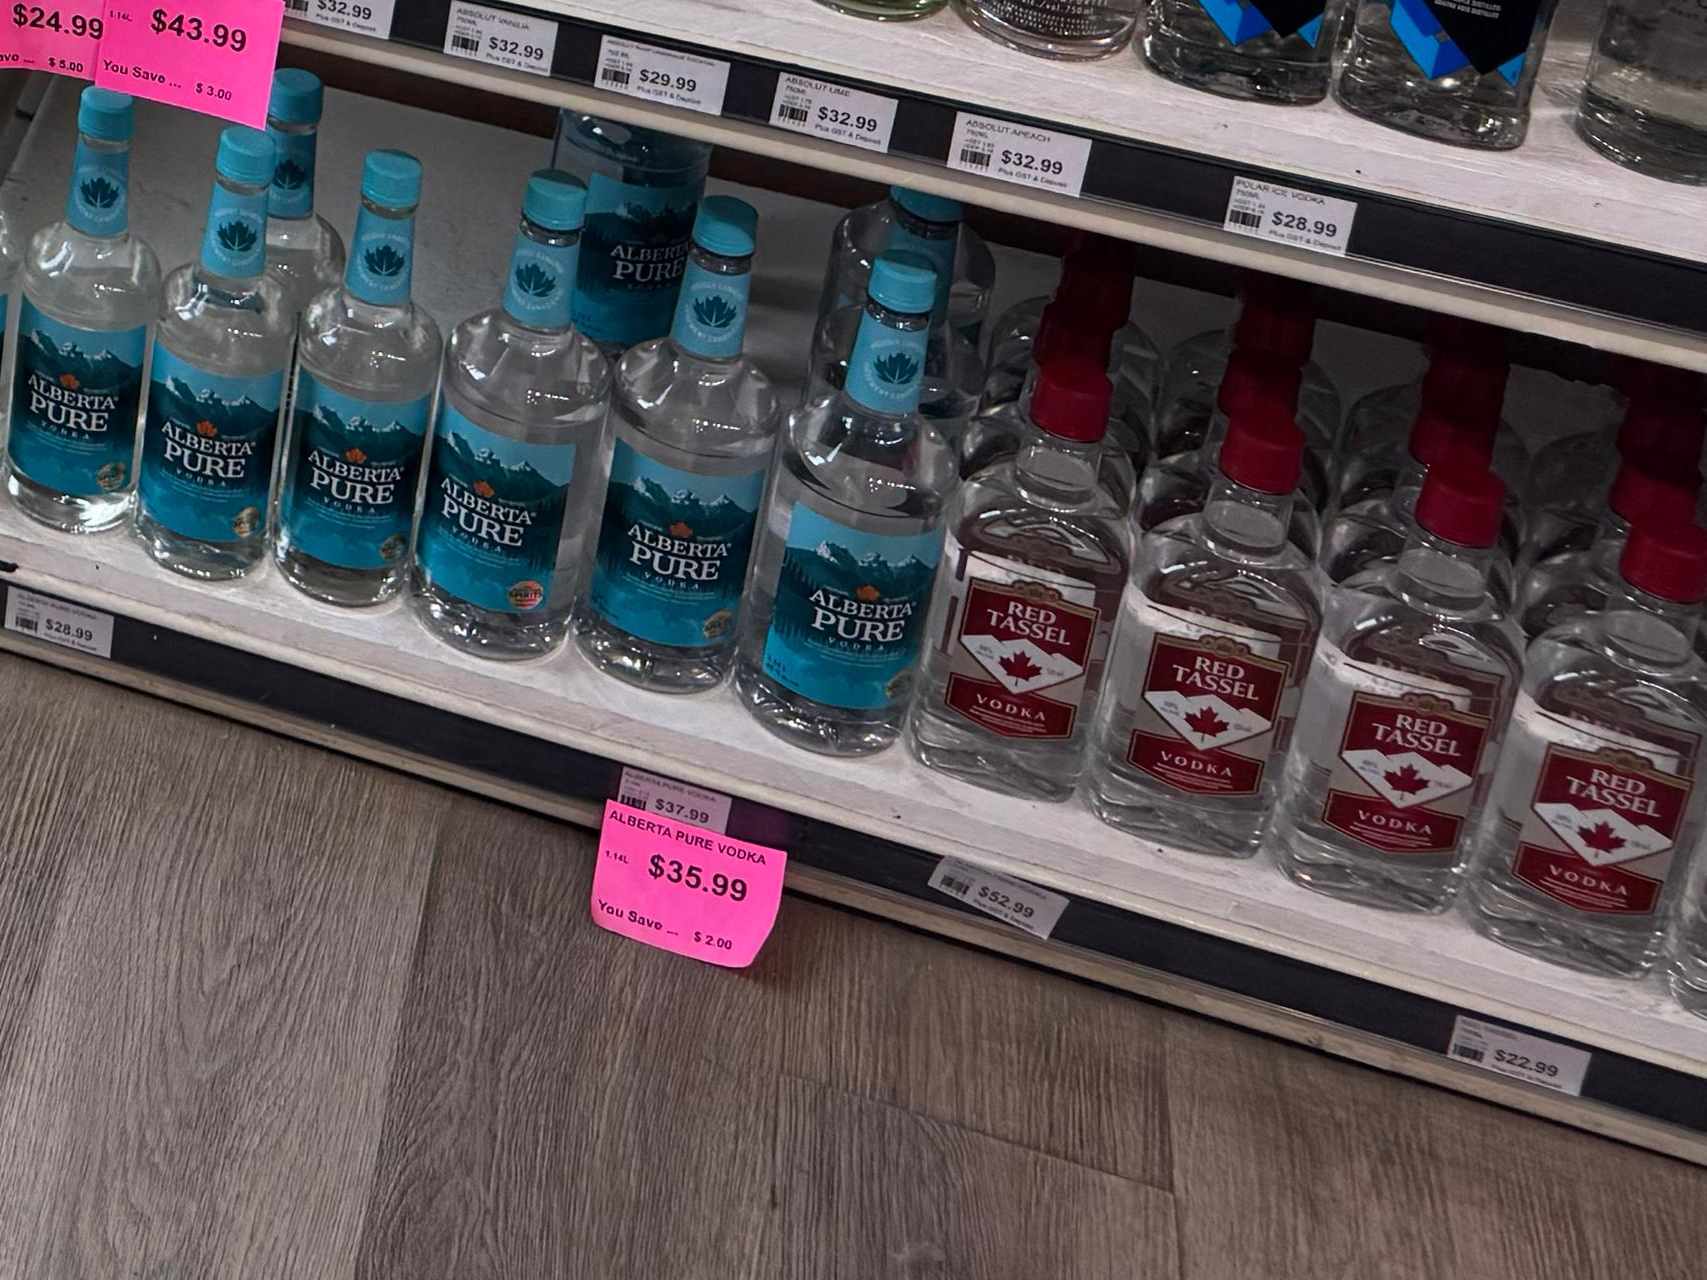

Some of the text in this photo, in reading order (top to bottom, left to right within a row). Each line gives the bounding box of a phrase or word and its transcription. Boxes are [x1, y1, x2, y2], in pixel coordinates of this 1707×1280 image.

[12, 2, 104, 41] $24.99
[150, 7, 247, 53] $43.99
[638, 68, 697, 93] $29.99
[817, 106, 878, 132] $32.99
[1001, 150, 1064, 175] $32.99
[1271, 211, 1338, 238] $28.99
[440, 476, 536, 526] ALBERTA
[441, 499, 523, 548] PURE
[809, 585, 915, 619] ALBERTA
[1007, 600, 1057, 626] RED
[44, 618, 94, 641] $28.99
[811, 607, 904, 643] PURE
[986, 611, 1071, 647] TASSEL
[975, 692, 1046, 722] VODKA
[1565, 774, 1661, 818] TASSEL
[1590, 768, 1647, 796] RED
[655, 798, 710, 824] $37.99
[609, 809, 767, 865] ALBERTA PURE VODKA
[648, 854, 748, 902] $35.99
[1549, 864, 1629, 896] VODKA
[978, 884, 1035, 920] $52.99
[705, 934, 733, 950] 2.00
[1494, 1049, 1559, 1077] $22.99
